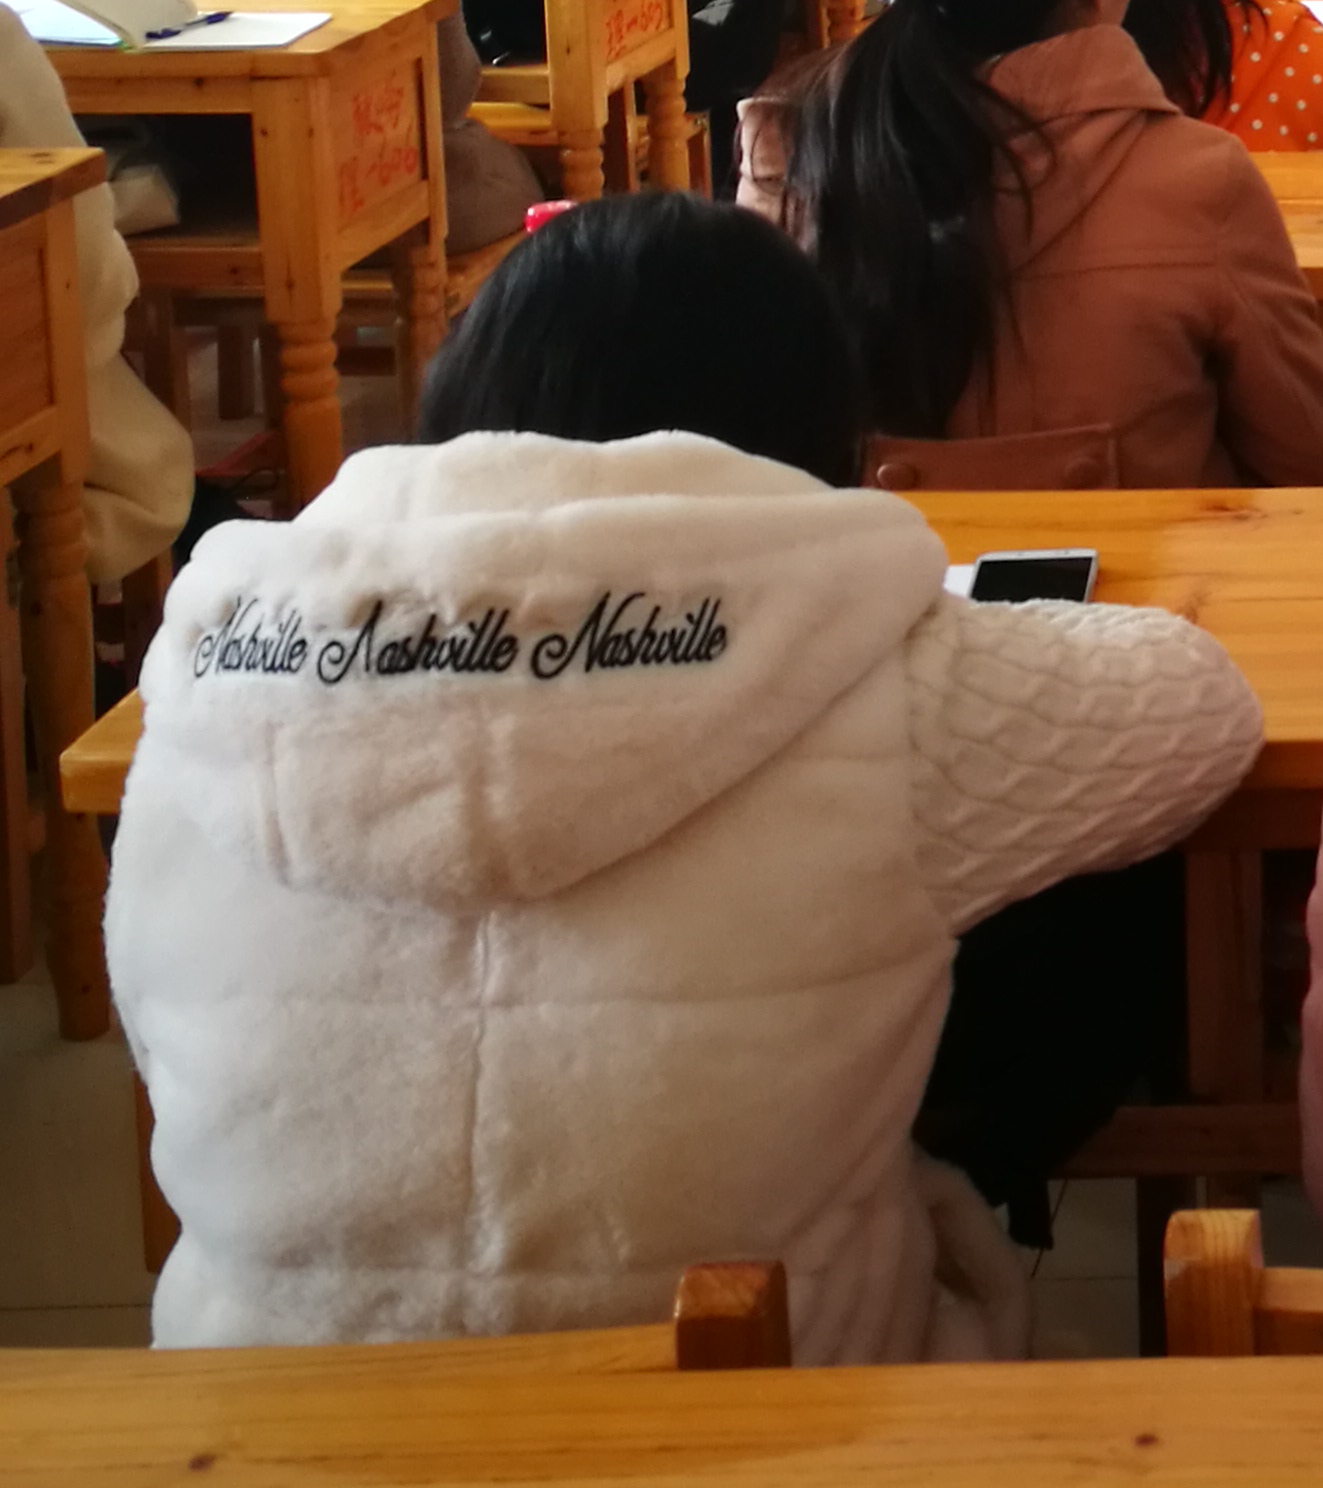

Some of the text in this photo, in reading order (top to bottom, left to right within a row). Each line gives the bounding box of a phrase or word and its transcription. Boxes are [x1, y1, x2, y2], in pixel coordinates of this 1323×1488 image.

[193, 590, 730, 683] Nashville Nashville Nashville
